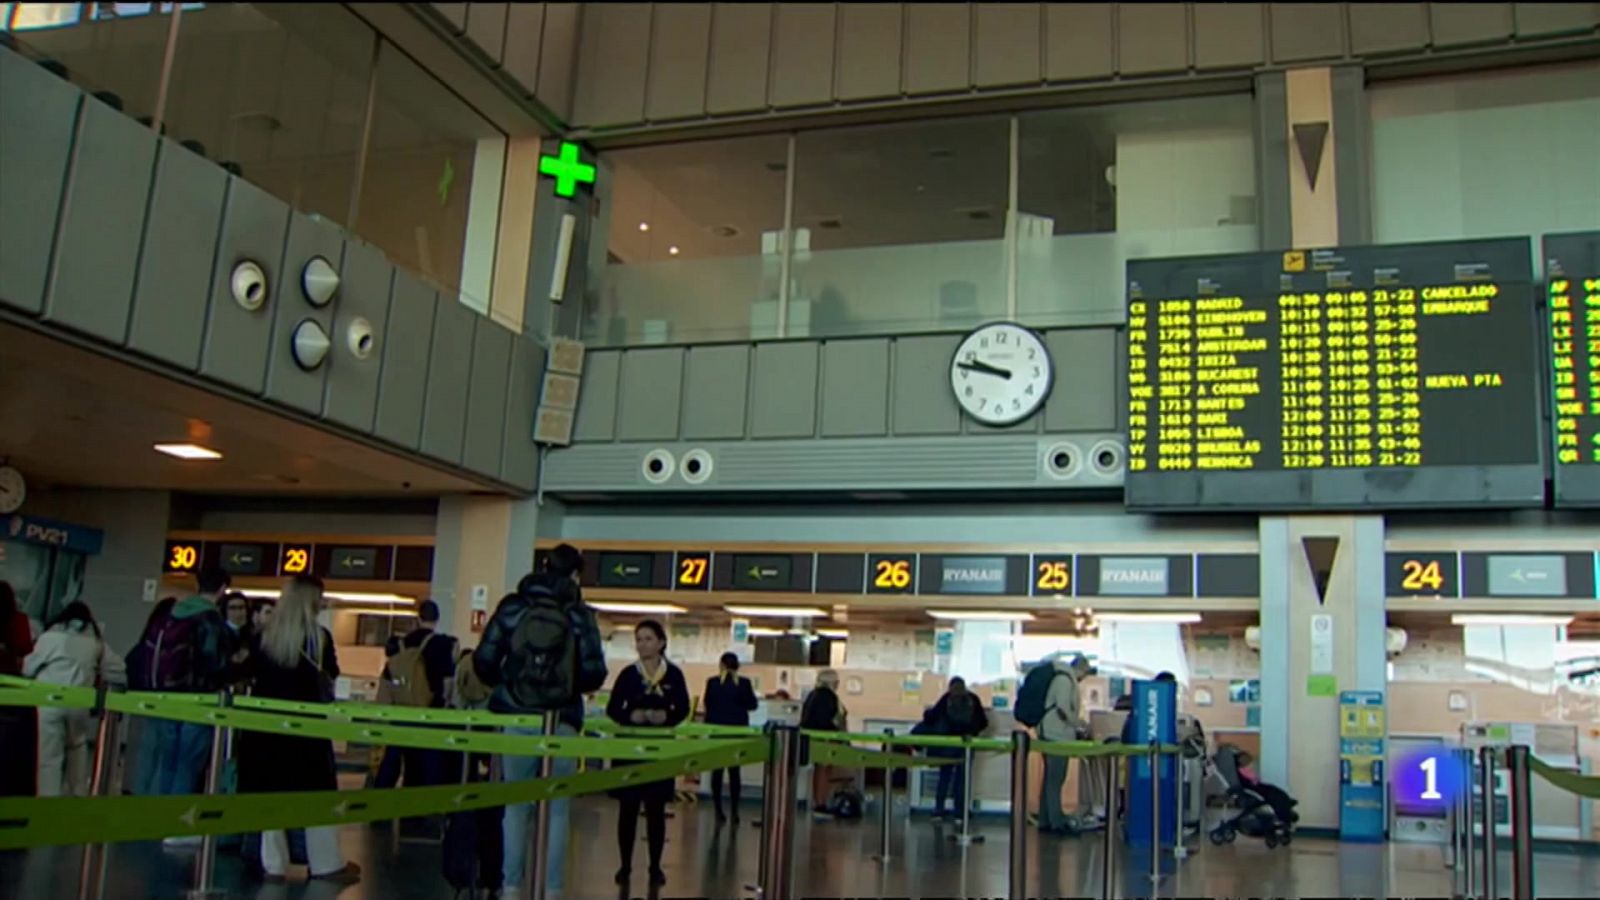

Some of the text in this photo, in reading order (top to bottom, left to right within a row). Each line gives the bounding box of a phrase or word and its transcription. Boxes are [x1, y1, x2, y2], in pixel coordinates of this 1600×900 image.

[1196, 297, 1242, 310] MADRID
[1374, 289, 1414, 302] 21-22
[1422, 284, 1498, 299] CANCELADO
[1196, 310, 1266, 324] EINDHOVEN
[1281, 309, 1320, 320] 10:10
[1423, 300, 1489, 313] EMBARQUE
[996, 332, 1008, 344] 12
[1130, 330, 1146, 341] FR
[1197, 326, 1244, 339] DUBLIN
[1016, 336, 1021, 347] 1
[1198, 339, 1266, 353] AMSTERDAM
[1281, 337, 1321, 349] 10:20
[1028, 348, 1035, 360] 2
[1198, 354, 1236, 366] IBIZA
[1282, 352, 1322, 363] 10:30
[1376, 348, 1416, 360] 21-22
[1033, 366, 1040, 378] 3
[1197, 367, 1257, 380] BUCAREST
[1025, 383, 1034, 396] 4
[1198, 385, 1206, 396] A
[1283, 380, 1322, 392] 11:00
[1425, 375, 1468, 388] NUEVA
[1474, 373, 1502, 386] PTA
[980, 398, 987, 410] 7
[994, 403, 1003, 415] 6
[1013, 398, 1021, 411] 5
[1130, 401, 1146, 412] FR
[1197, 398, 1245, 410] NANTES
[1130, 415, 1146, 426] FR
[1283, 410, 1323, 421] 12:00
[1131, 429, 1146, 440] TP
[1197, 426, 1244, 439] LISBOA
[1283, 425, 1323, 436] 12:00
[1130, 444, 1146, 455] VY
[1197, 440, 1260, 453] BRUSELAS
[1283, 440, 1323, 451] 12:10
[1197, 455, 1253, 468] MENORCA
[1284, 454, 1325, 467] 12:20
[1379, 452, 1420, 465] 21-22
[26, 524, 68, 545] PV21
[170, 546, 196, 569] 30
[284, 549, 307, 572] 29
[680, 559, 707, 584] 27
[875, 561, 910, 588] 26
[944, 568, 1003, 582] RYANAIR
[1037, 563, 1068, 590] 25
[1102, 570, 1164, 583] RYANAIR
[1402, 560, 1444, 590] 24
